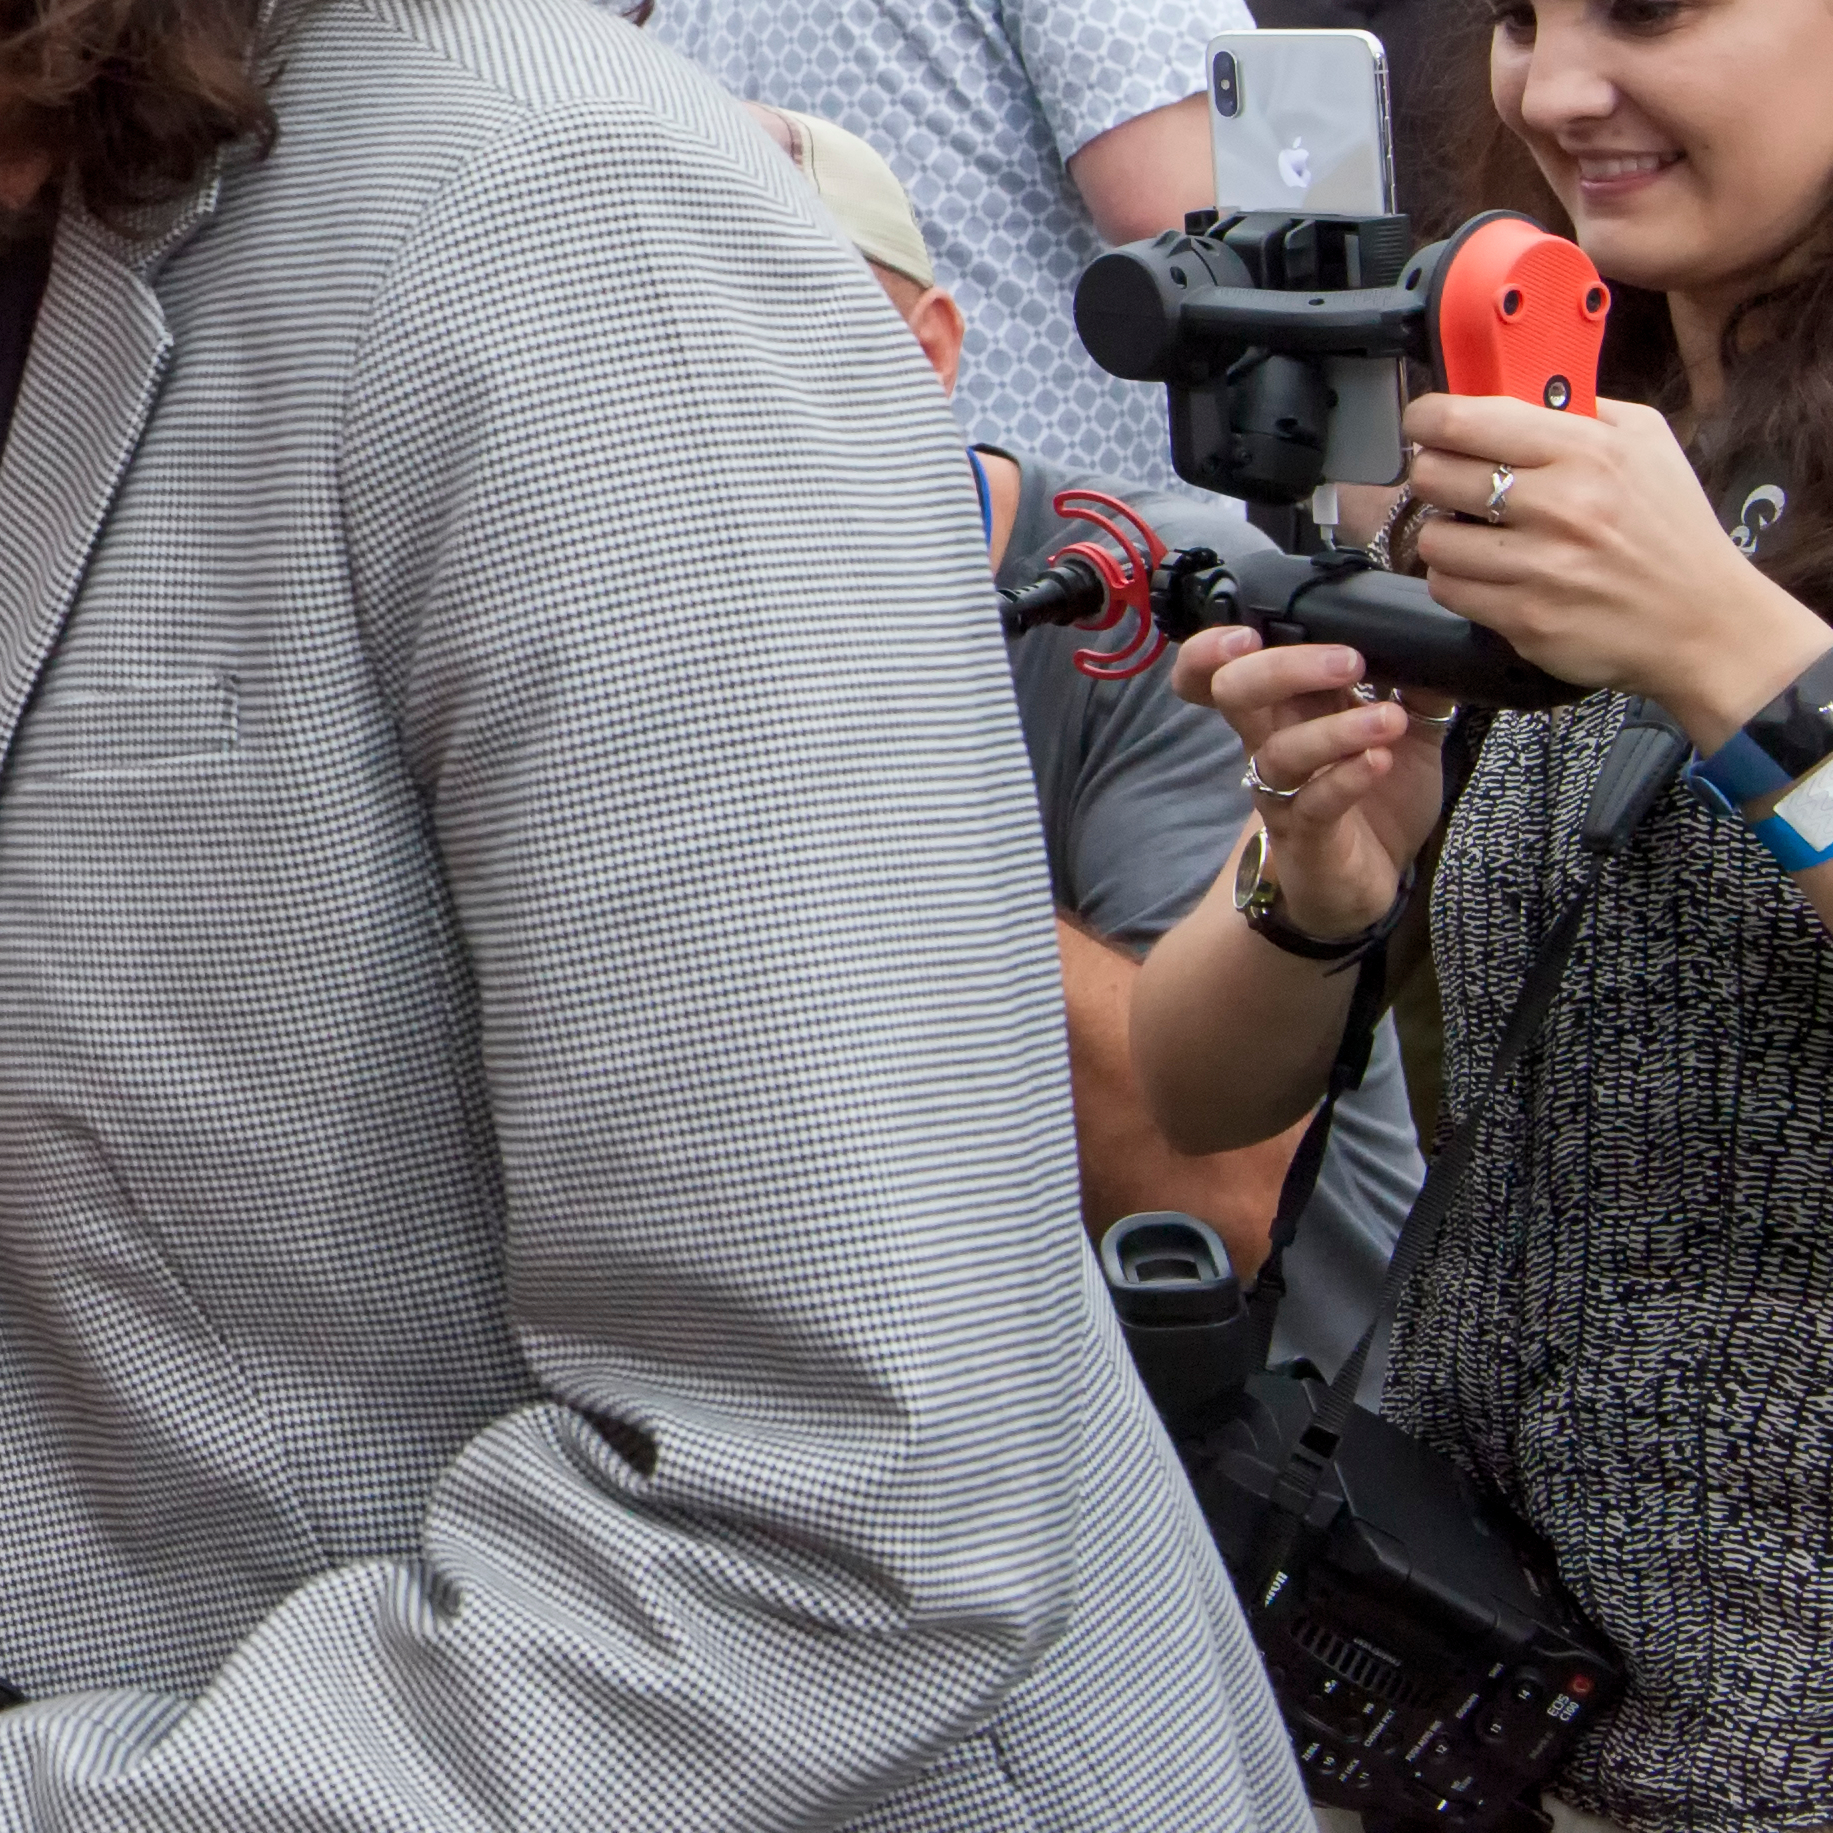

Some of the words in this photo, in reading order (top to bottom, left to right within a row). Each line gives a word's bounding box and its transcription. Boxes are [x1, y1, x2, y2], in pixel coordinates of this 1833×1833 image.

[1518, 1688, 1532, 1700] 14
[1546, 1692, 1571, 1718] EOS
[1558, 1700, 1582, 1723] C100
[1490, 1722, 1503, 1734] 13
[1436, 1743, 1448, 1755] 12
